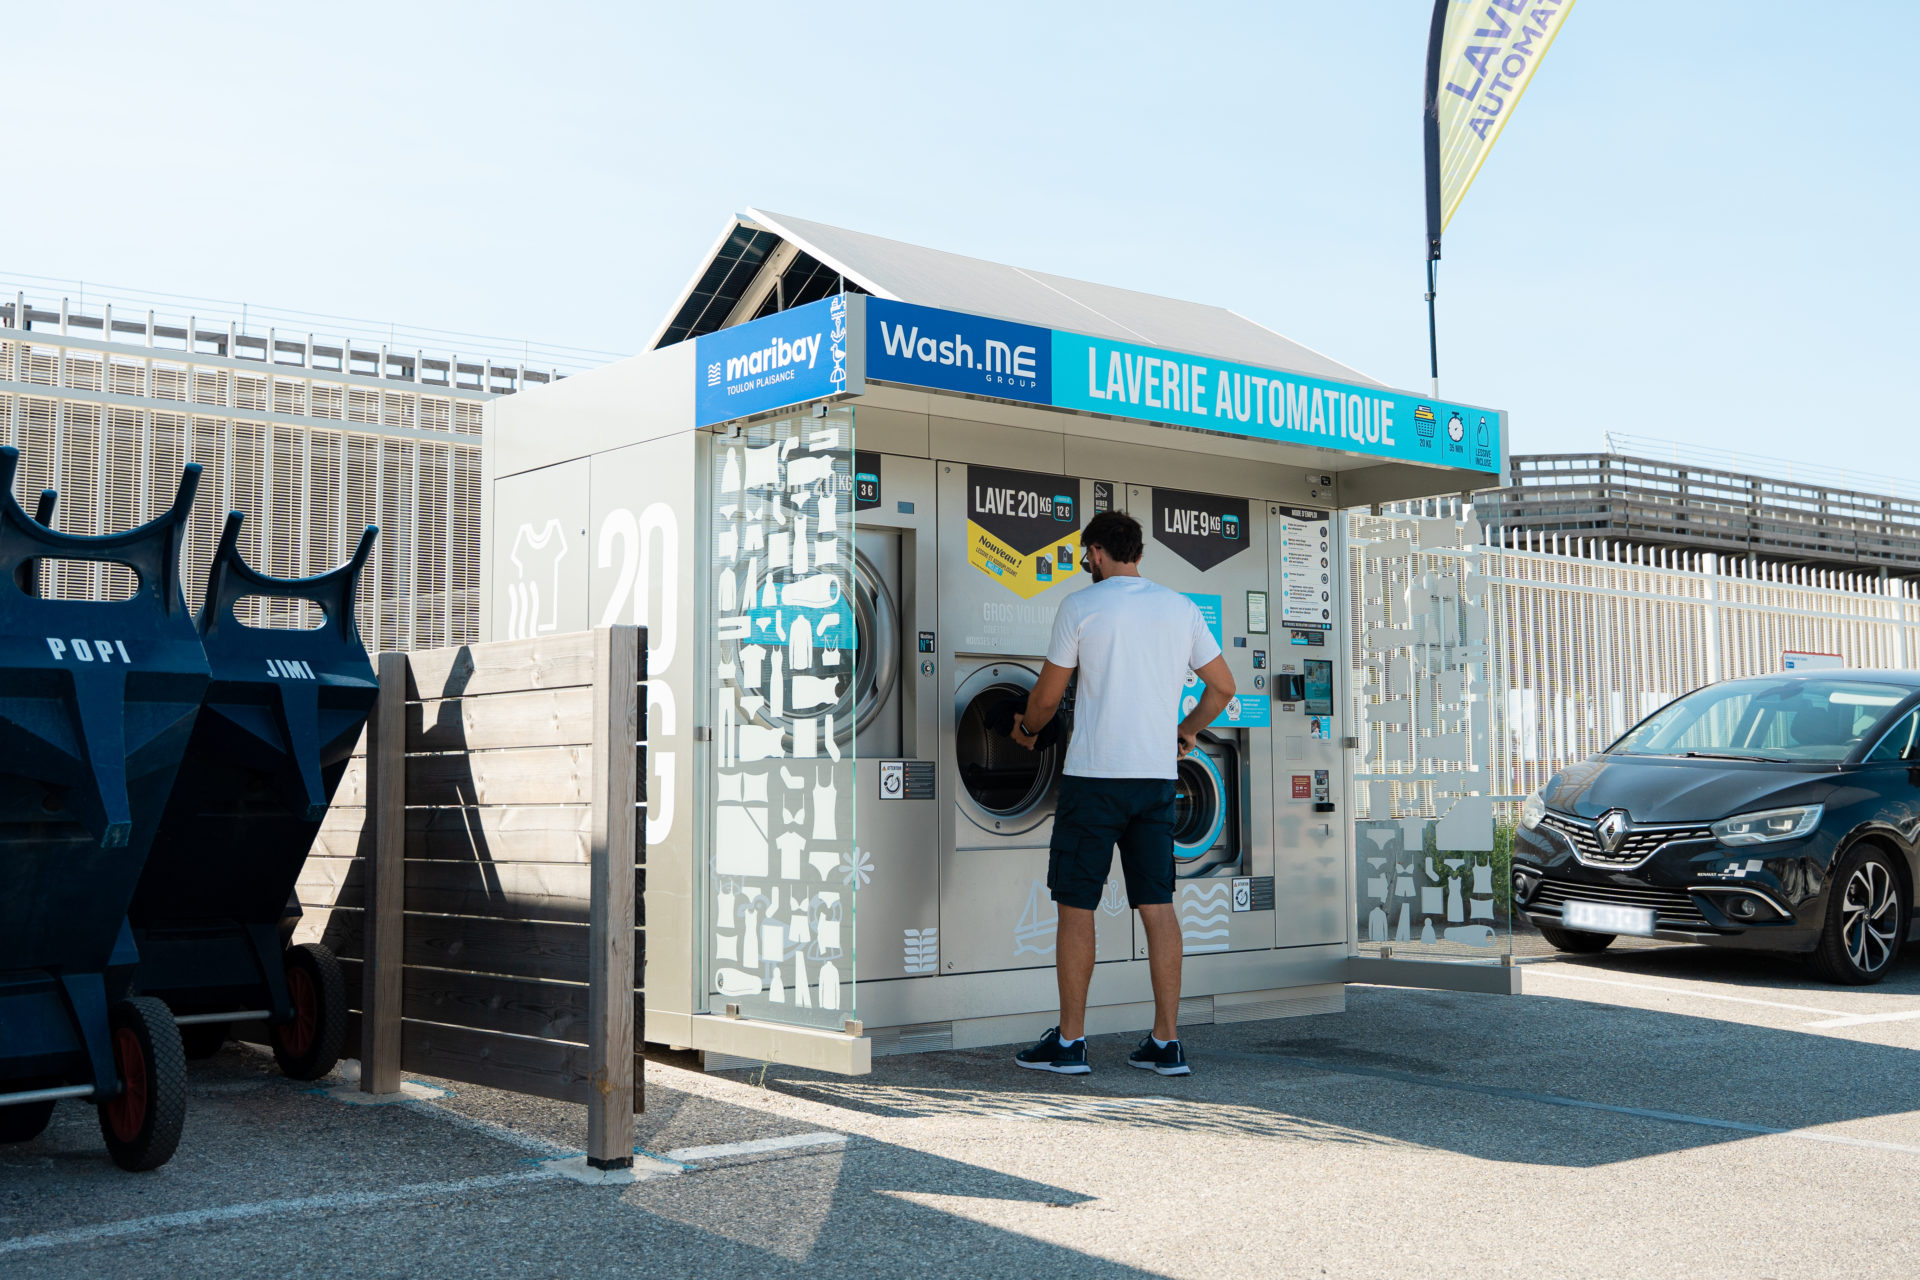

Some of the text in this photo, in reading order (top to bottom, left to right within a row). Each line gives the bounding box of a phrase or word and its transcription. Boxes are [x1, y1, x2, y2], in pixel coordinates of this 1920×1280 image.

[726, 333, 822, 382] maribay
[727, 369, 795, 396] TOULON PLAISANCE
[985, 374, 1036, 389] GROUP
[1088, 346, 1396, 447] LAVERIE AUTOMATIQUE
[1420, 439, 1432, 448] 20 KG
[1476, 449, 1491, 458] LESSIVE
[975, 485, 1052, 519] LAVE 20 KG
[1164, 507, 1221, 537] LAVE 9 KG
[978, 535, 1018, 567] Nouveau
[598, 502, 679, 676] 20
[983, 602, 1014, 622] GROS
[46, 637, 131, 664] POPI
[266, 659, 316, 680] JIMI
